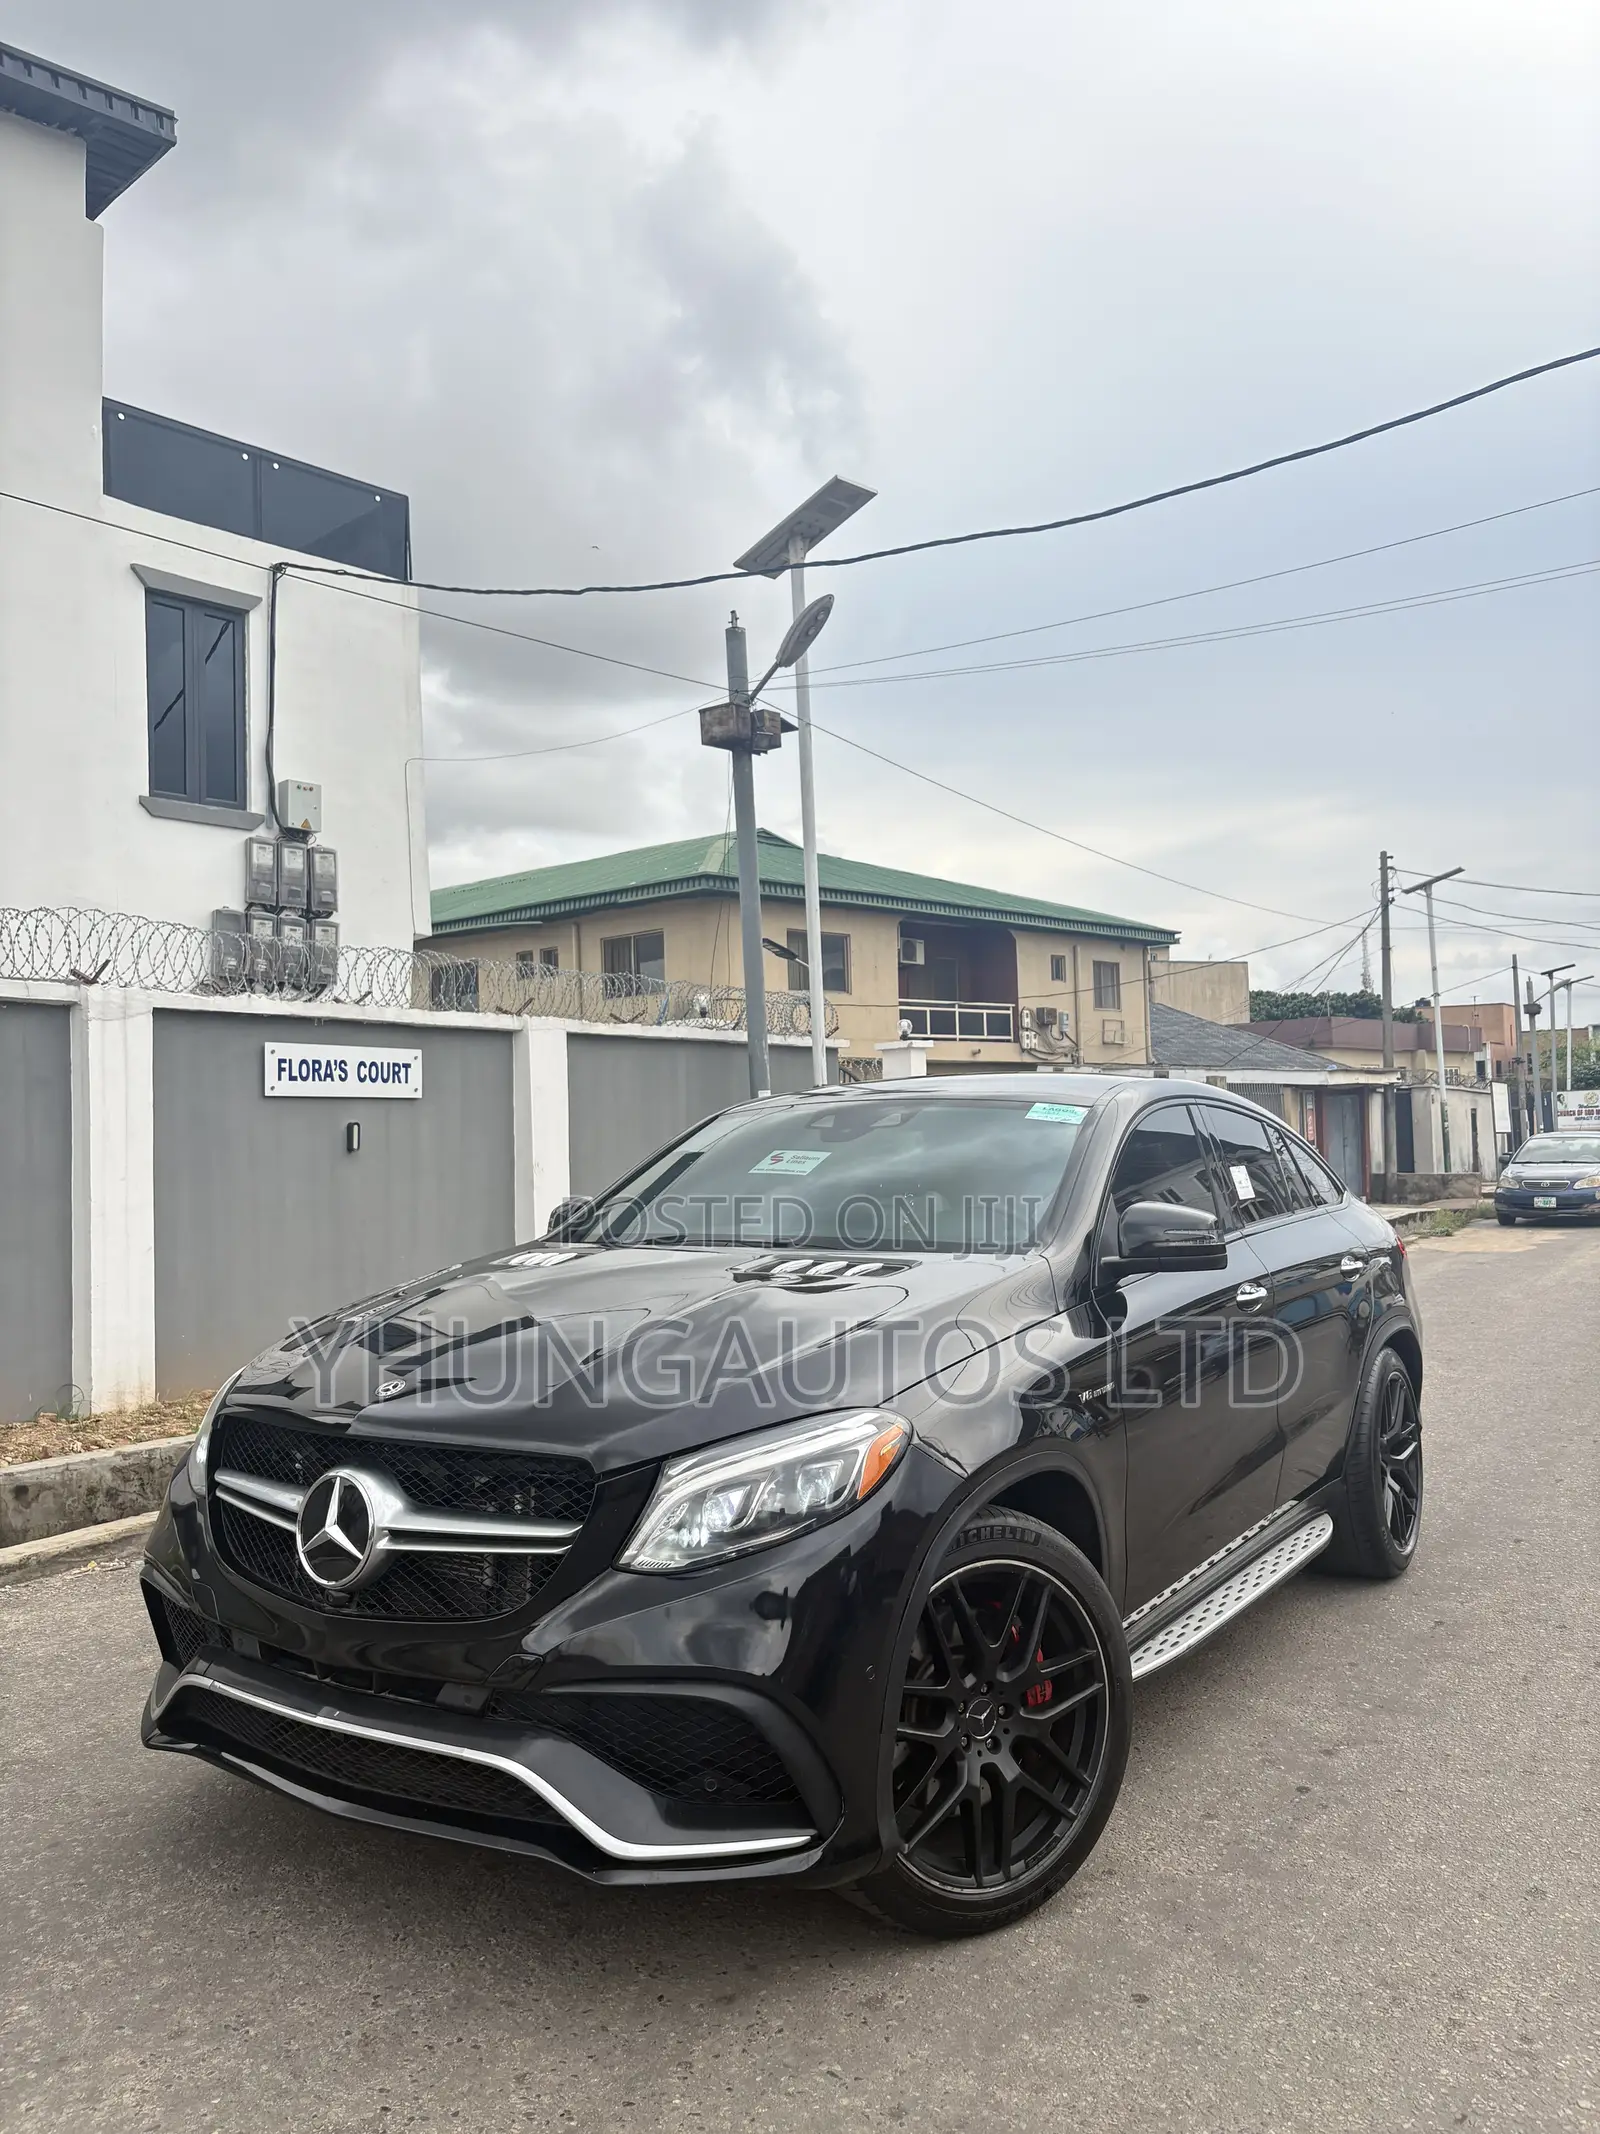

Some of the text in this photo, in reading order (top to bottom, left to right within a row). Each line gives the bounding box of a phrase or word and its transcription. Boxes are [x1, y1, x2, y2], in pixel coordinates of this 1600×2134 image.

[277, 1058, 412, 1084] FLORA'S COURT
[951, 1526, 1037, 1549] ICHELIN
